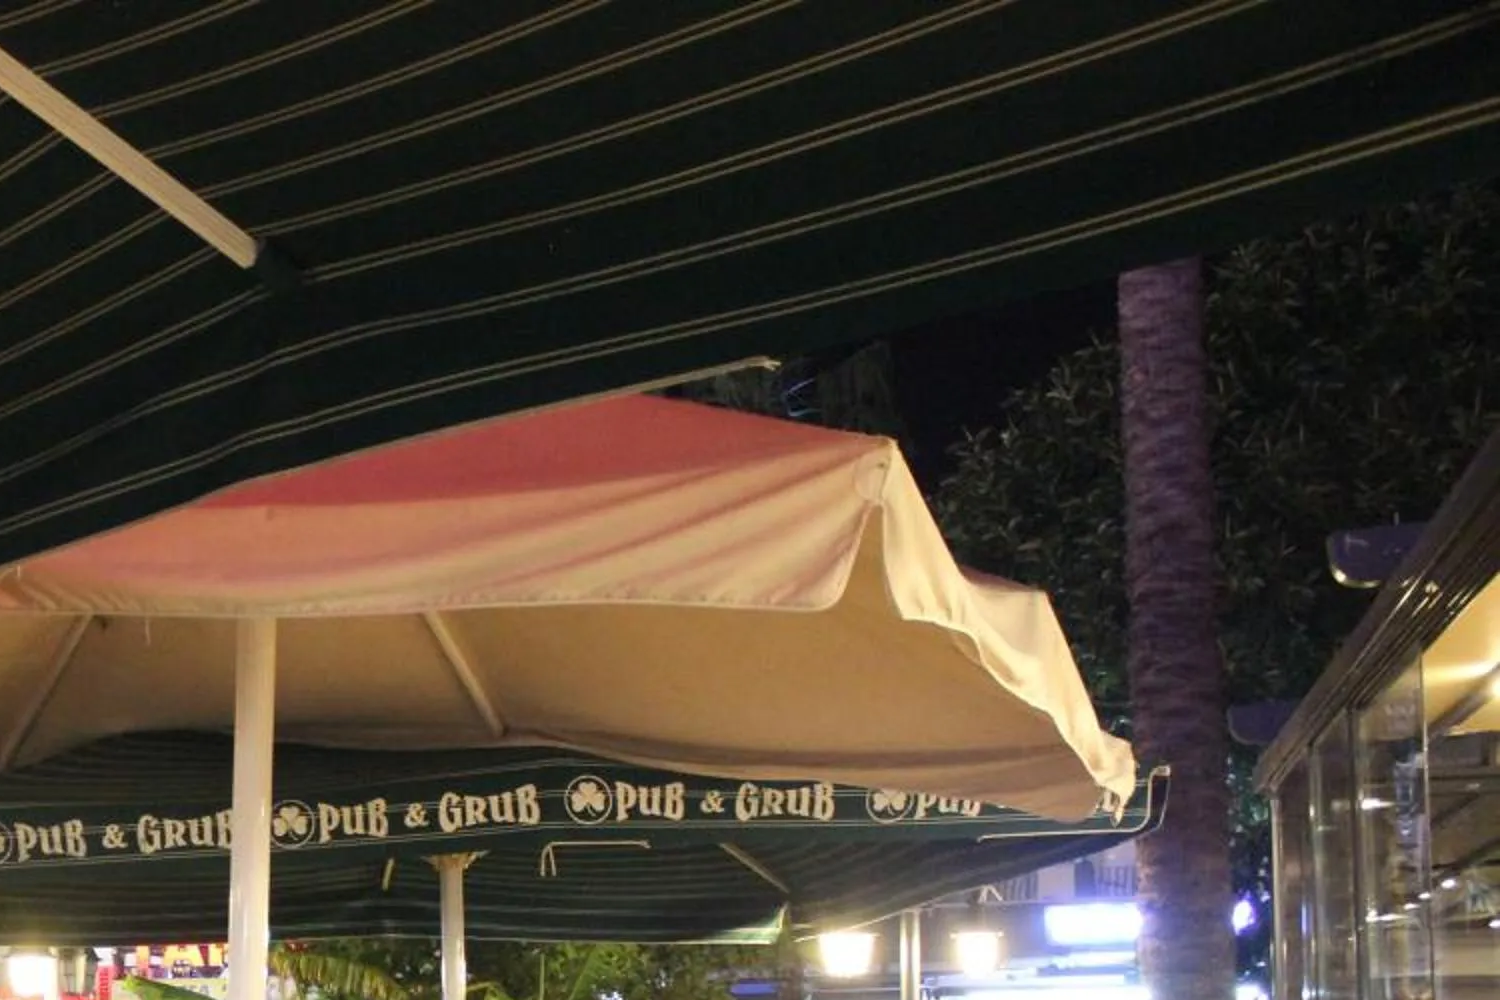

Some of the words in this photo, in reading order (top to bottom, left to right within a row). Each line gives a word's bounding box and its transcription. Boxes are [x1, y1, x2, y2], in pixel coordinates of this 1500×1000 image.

[317, 797, 389, 844] PUB
[403, 802, 430, 828] &
[438, 783, 541, 833] GRUB
[615, 780, 685, 822] PUB
[700, 789, 726, 813] &
[735, 780, 835, 822] GRUB
[13, 818, 88, 863] PUB
[102, 823, 129, 849] &
